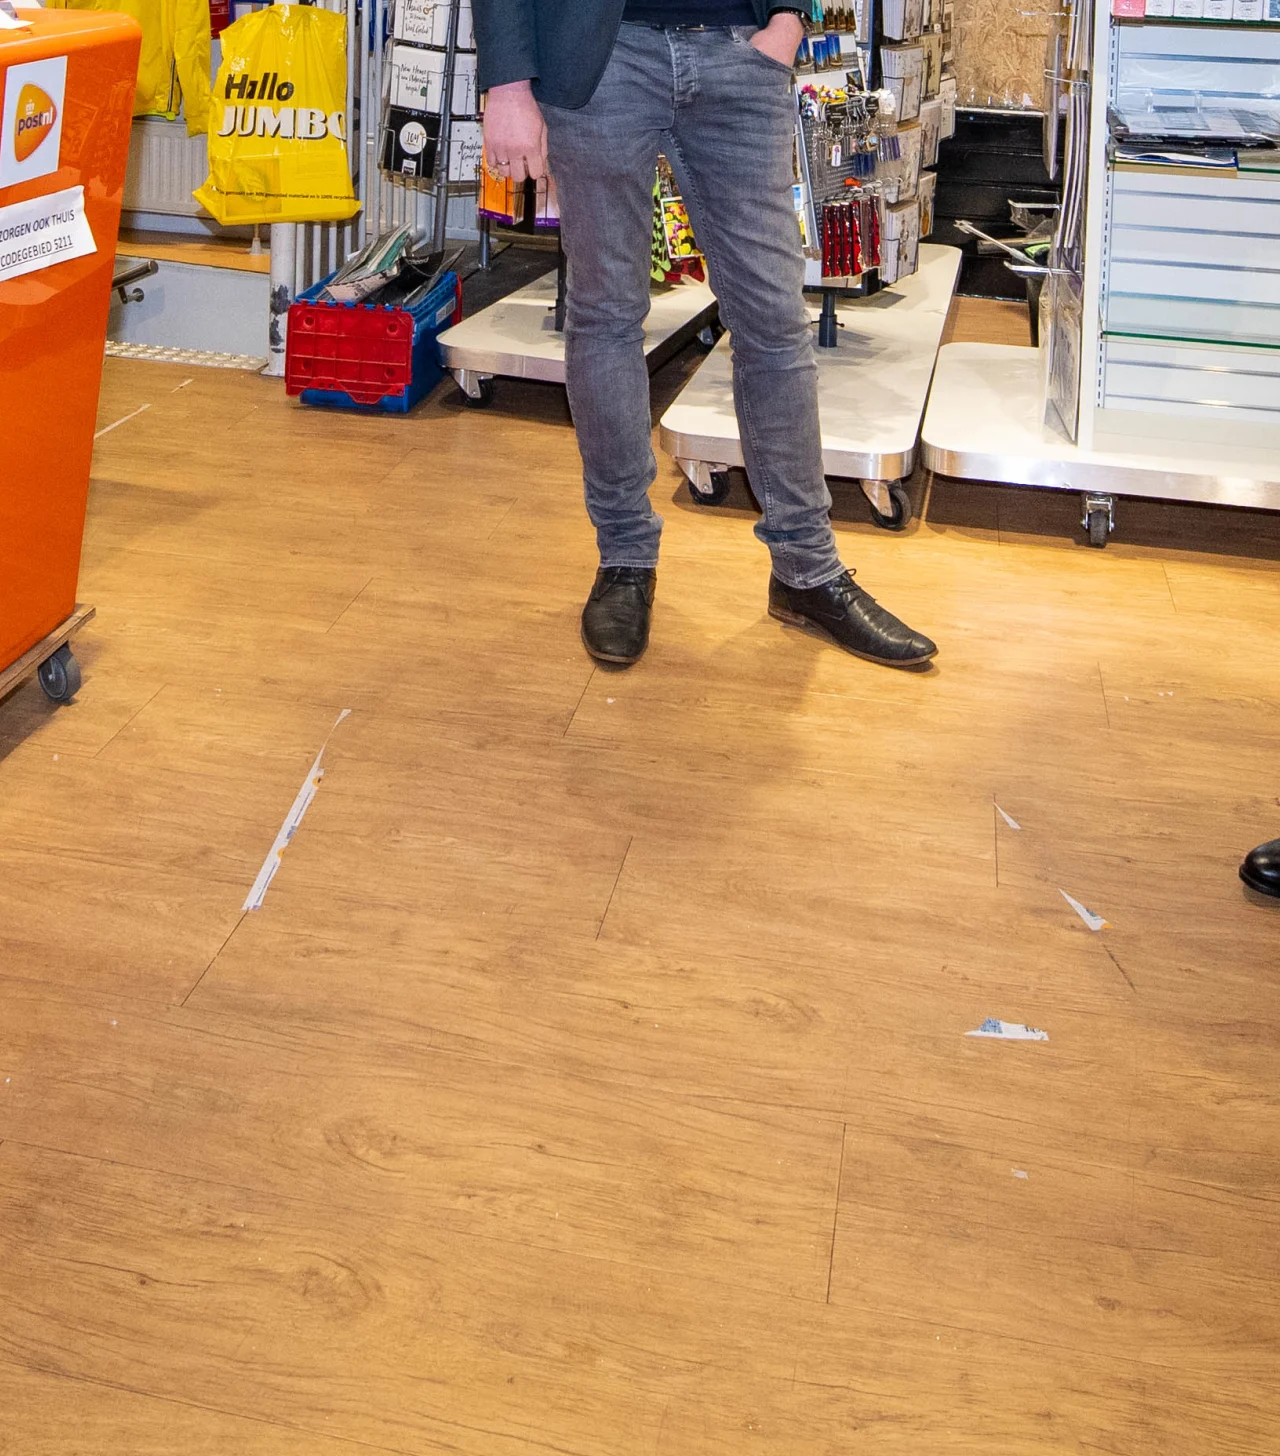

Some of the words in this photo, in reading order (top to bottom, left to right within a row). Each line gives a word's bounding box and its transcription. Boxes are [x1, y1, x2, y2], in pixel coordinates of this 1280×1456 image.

[224, 72, 295, 101] Hallo
[17, 106, 54, 136] postnl
[32, 216, 51, 232] OOK
[51, 209, 76, 226] THUIS
[53, 234, 73, 251] 5211
